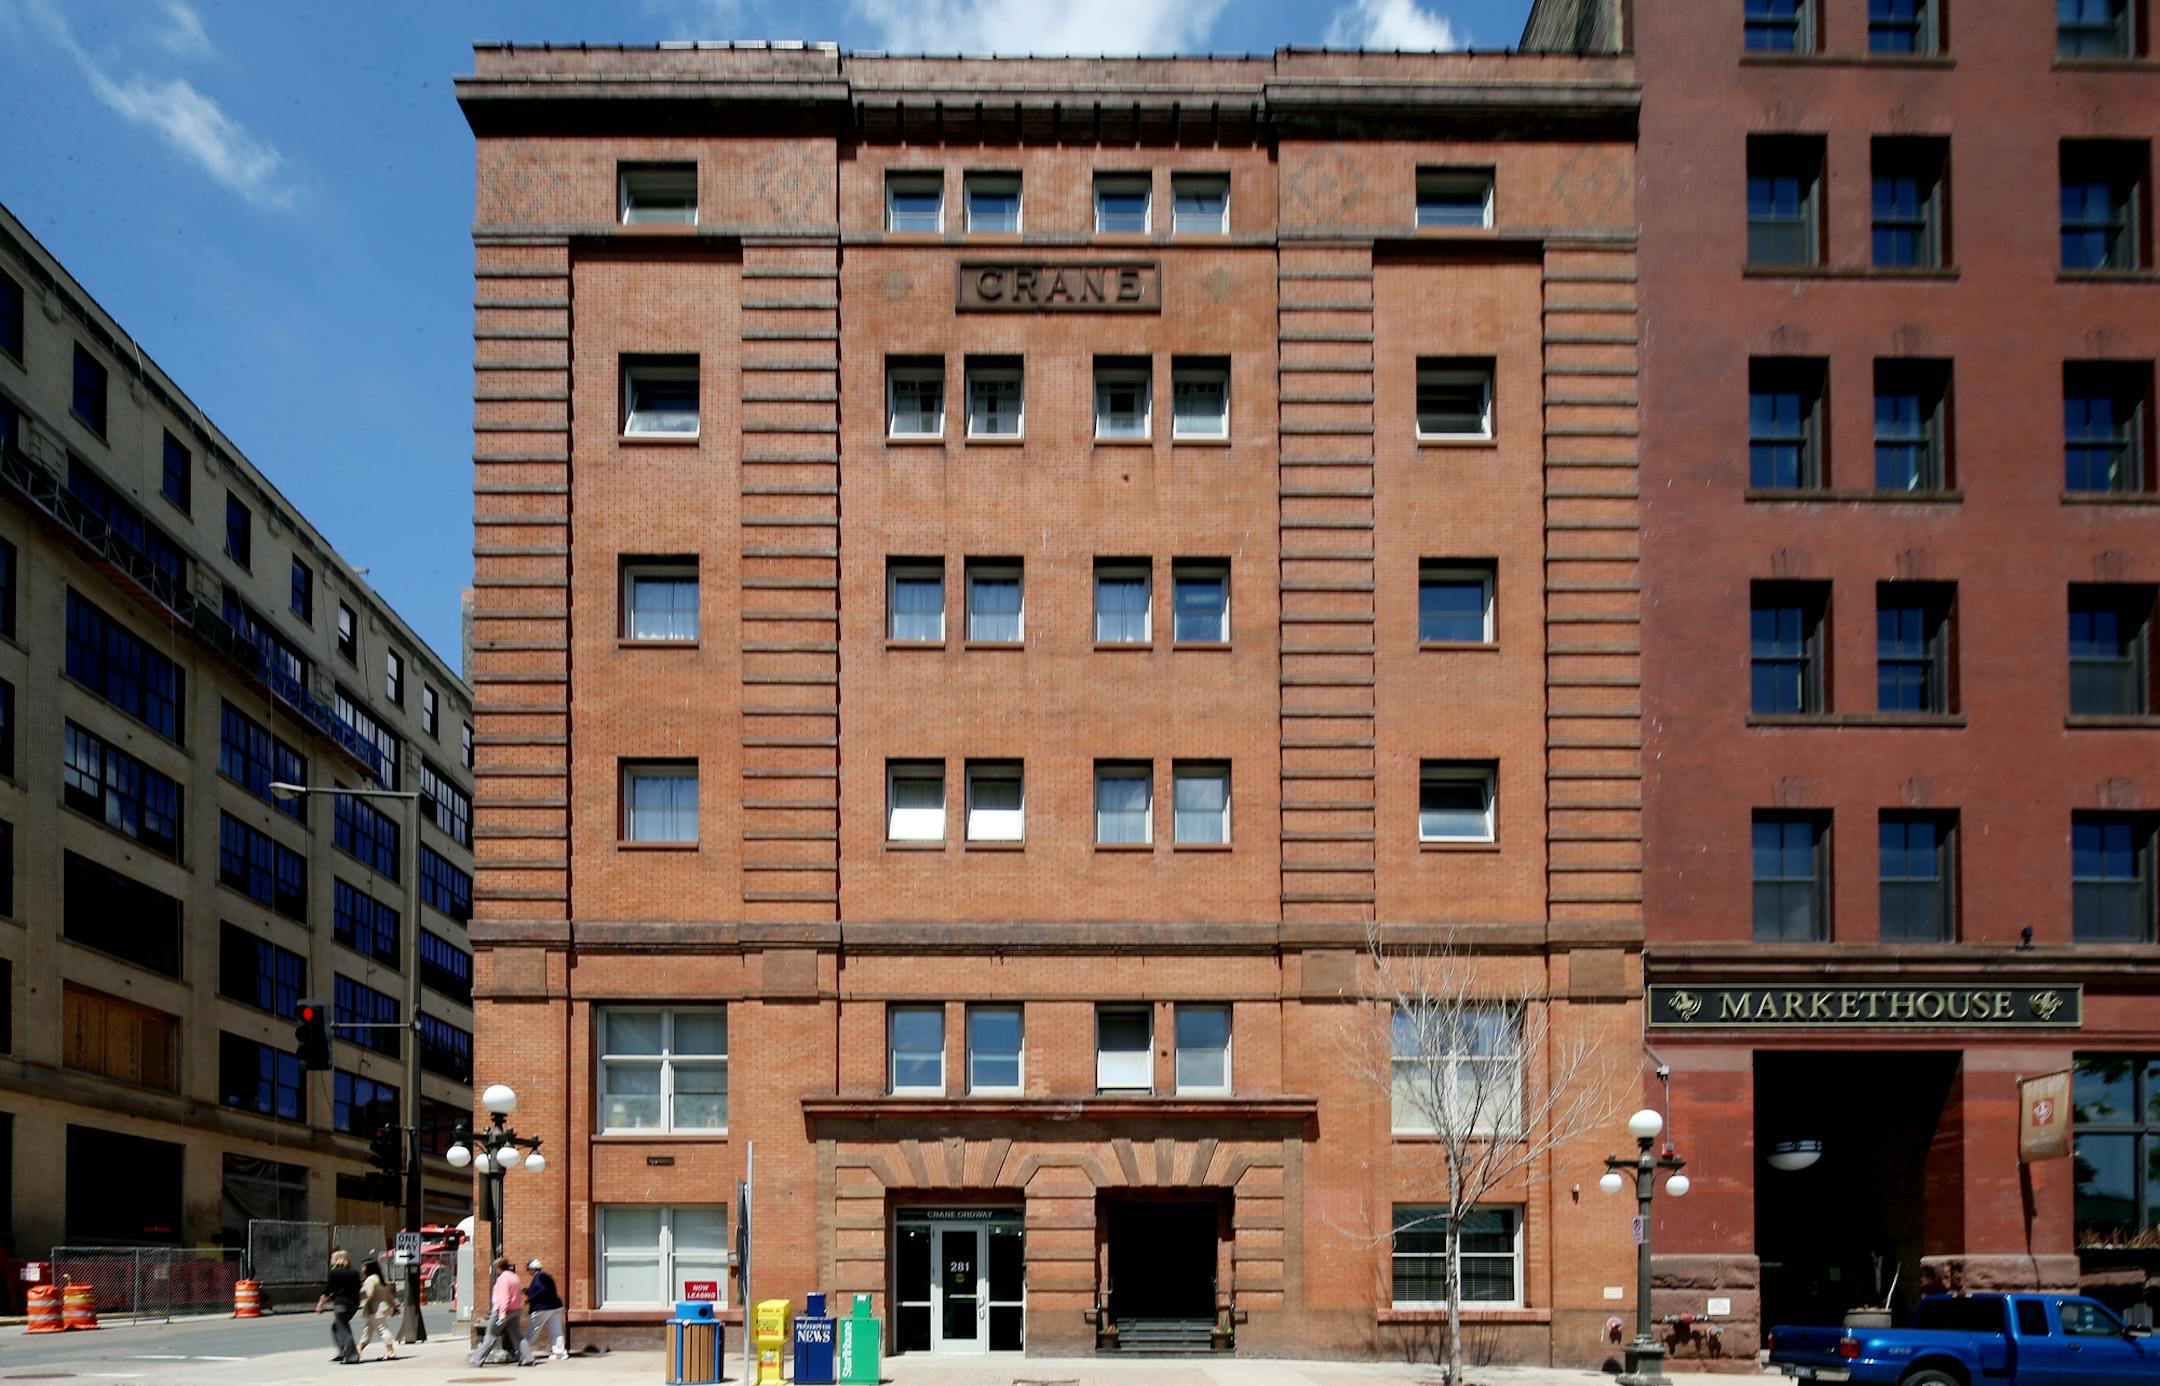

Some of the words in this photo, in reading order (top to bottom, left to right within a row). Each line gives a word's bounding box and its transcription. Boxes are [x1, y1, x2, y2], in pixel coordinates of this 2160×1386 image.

[976, 267, 1140, 303] CRANE
[1718, 990, 2016, 1021] MARKETHOUSE
[927, 1210, 956, 1218] CRANE
[957, 1210, 993, 1218] ORDWAY
[398, 1234, 418, 1242] ONE
[398, 1243, 418, 1251] WAY
[950, 1261, 970, 1272] 281
[797, 1330, 831, 1343] NEWS
